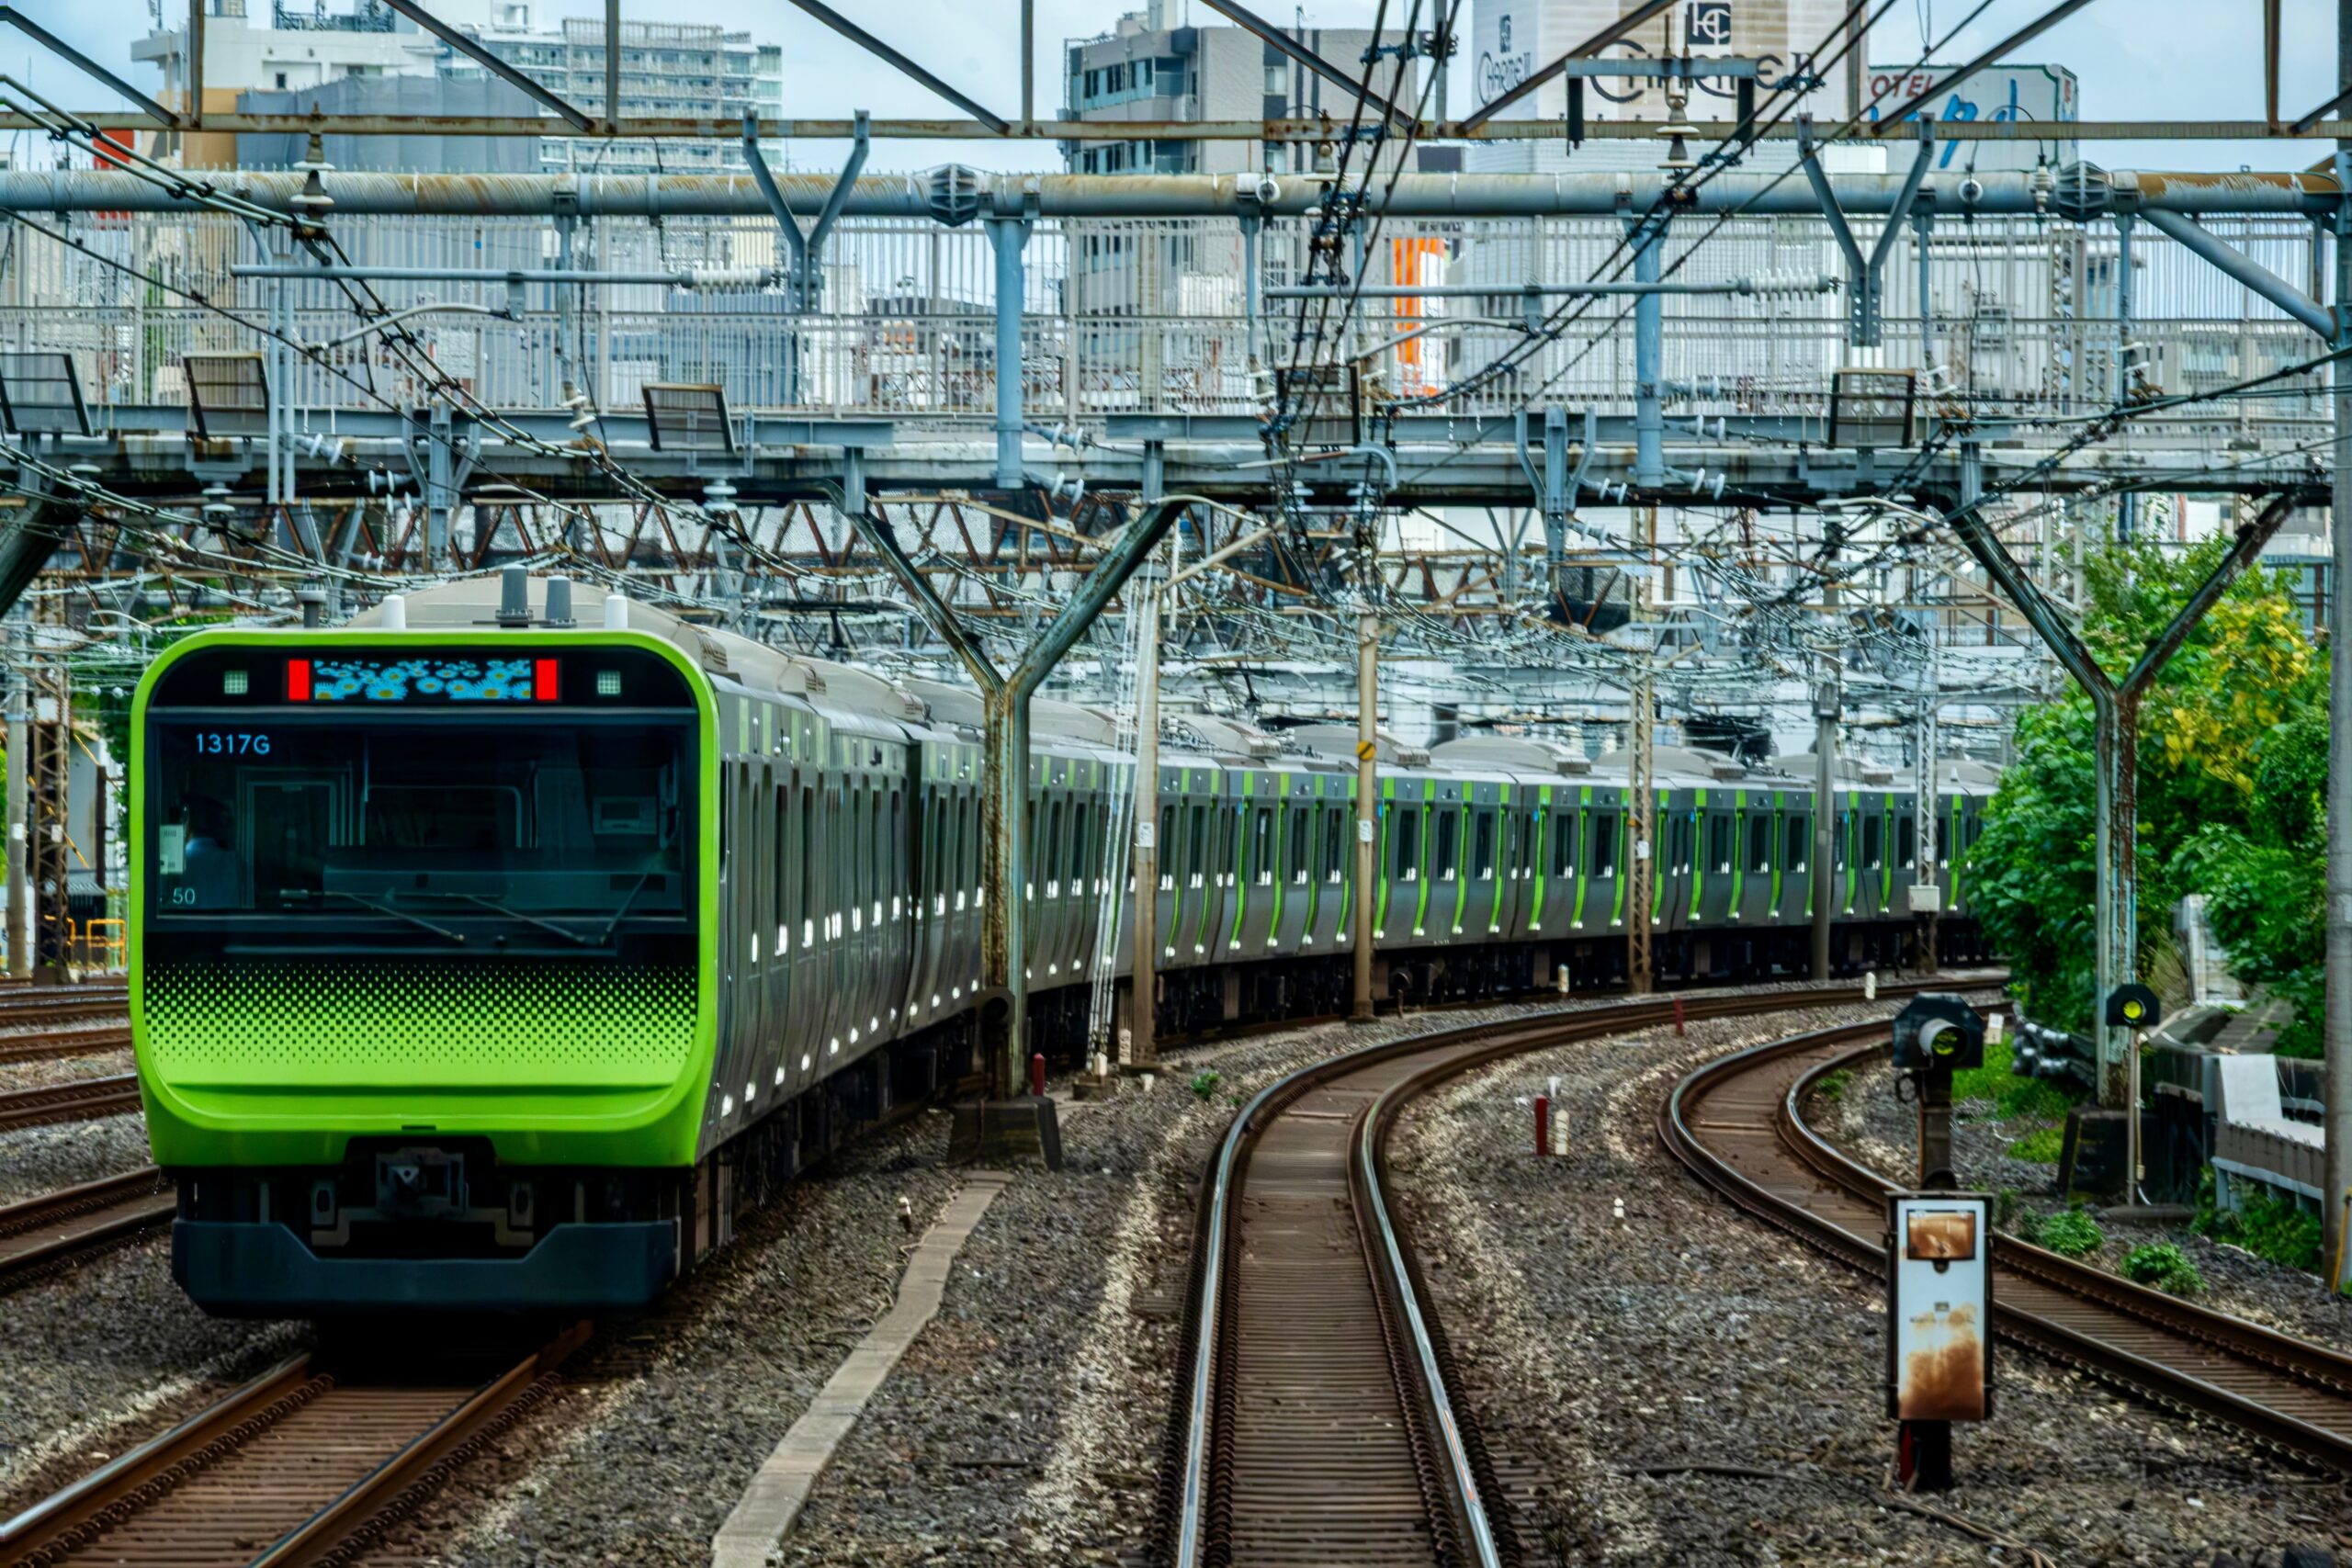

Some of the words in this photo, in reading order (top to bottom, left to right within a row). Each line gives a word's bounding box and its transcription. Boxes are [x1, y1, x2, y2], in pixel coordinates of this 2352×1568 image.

[1868, 74, 1934, 99] OTEL
[197, 733, 270, 755] 1317G
[173, 886, 196, 905] 50
